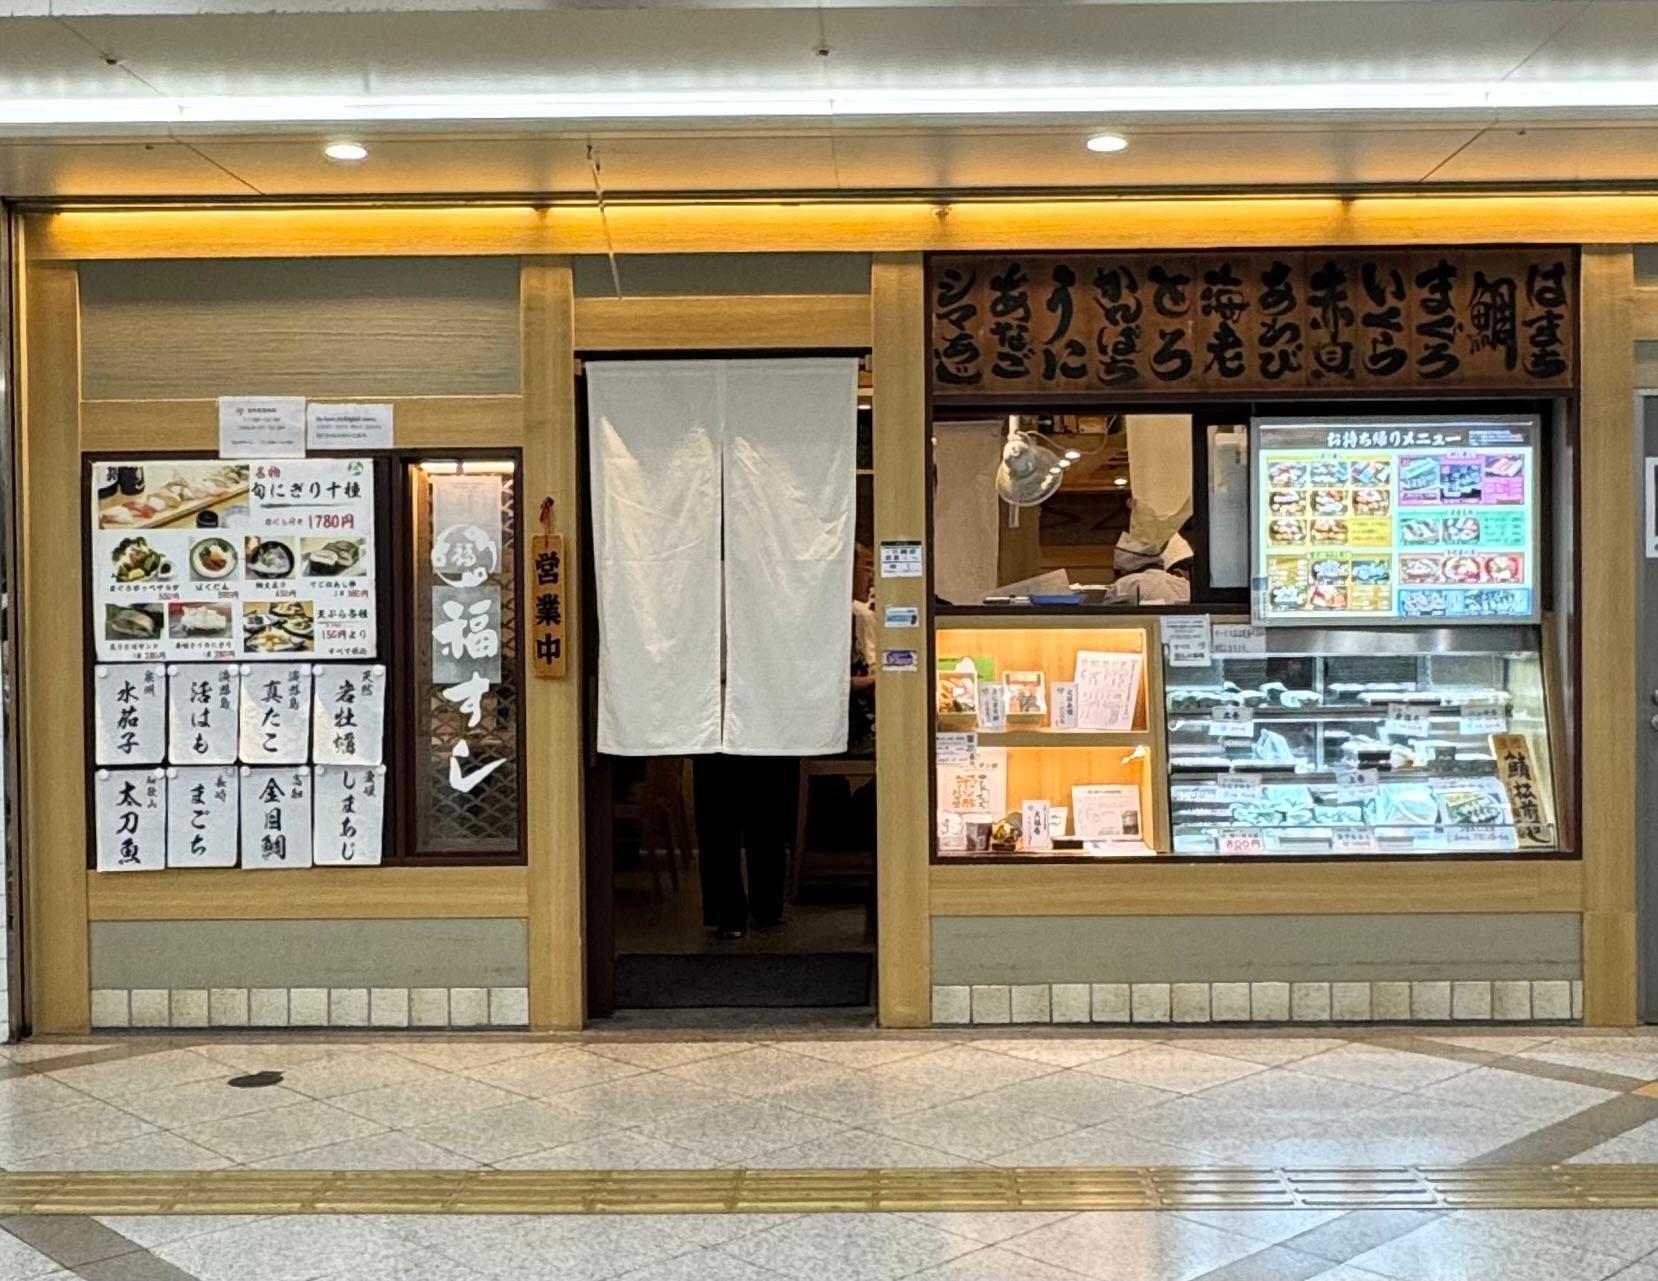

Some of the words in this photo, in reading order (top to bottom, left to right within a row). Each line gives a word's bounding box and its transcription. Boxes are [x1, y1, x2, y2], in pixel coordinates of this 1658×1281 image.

[990, 262, 1035, 379] あなご
[1043, 264, 1088, 381] うに
[1148, 264, 1193, 381] とろ
[1201, 262, 1250, 378] 海老
[1258, 260, 1302, 379] あわび
[1307, 260, 1355, 379] 赤貝
[1361, 262, 1407, 376] いくら
[1415, 259, 1464, 379] まぐろ
[1467, 270, 1517, 371] 鯛
[1521, 262, 1567, 379] はまち
[256, 466, 281, 479] 名物
[1327, 431, 1462, 448] お持ち帰りメニュー
[251, 481, 362, 500] 旬にぎり十種
[308, 513, 355, 529] 1780円
[317, 609, 368, 619] 天ぷら各種
[535, 551, 561, 665] 営業中
[116, 680, 140, 754] 水茄子
[190, 681, 213, 754] 活はも
[261, 680, 283, 753] 真たこ
[432, 600, 506, 793] 福すし
[116, 781, 142, 865] 太刀魚
[190, 783, 210, 855] まごち
[259, 778, 286, 860] 金目鯛
[339, 770, 357, 861] しまあじ
